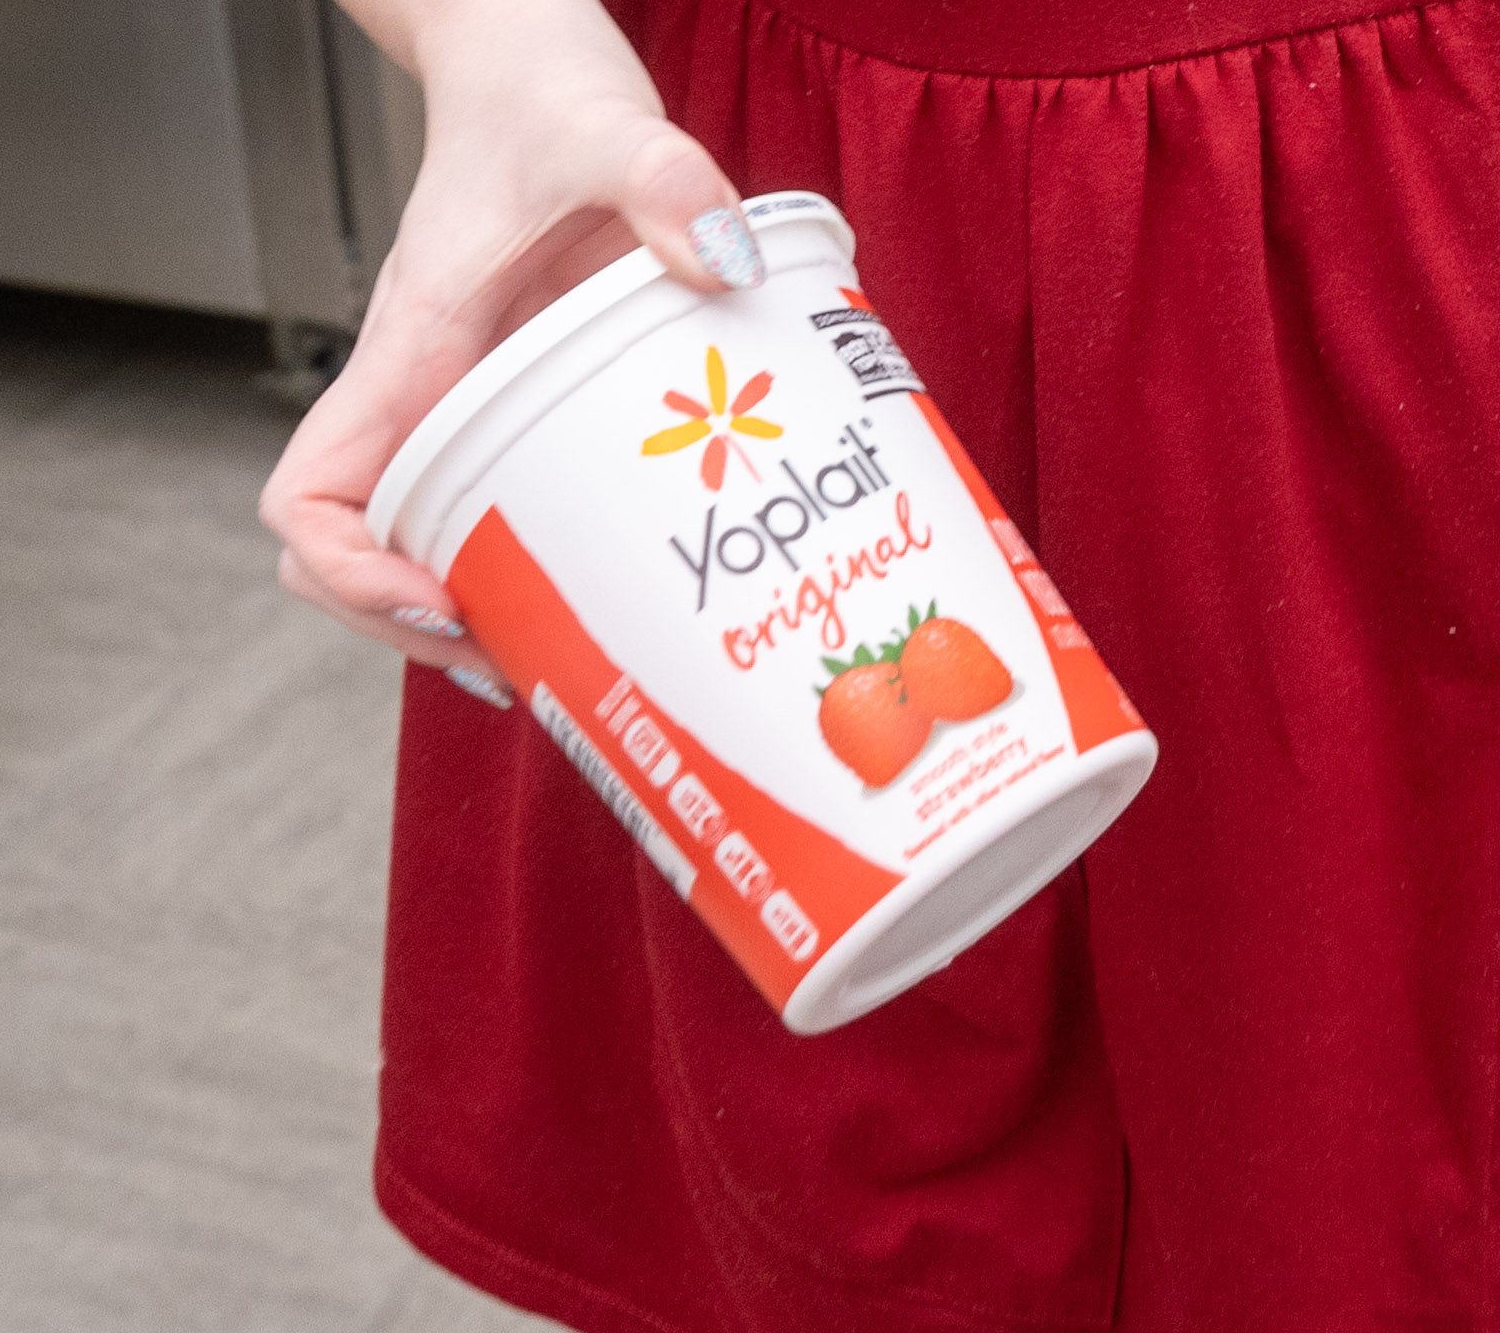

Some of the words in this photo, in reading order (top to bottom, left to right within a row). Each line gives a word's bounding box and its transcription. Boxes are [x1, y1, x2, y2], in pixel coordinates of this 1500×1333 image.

[667, 423, 892, 614] Yoplait
[721, 489, 933, 671] original
[915, 735, 1028, 823] strawberry
